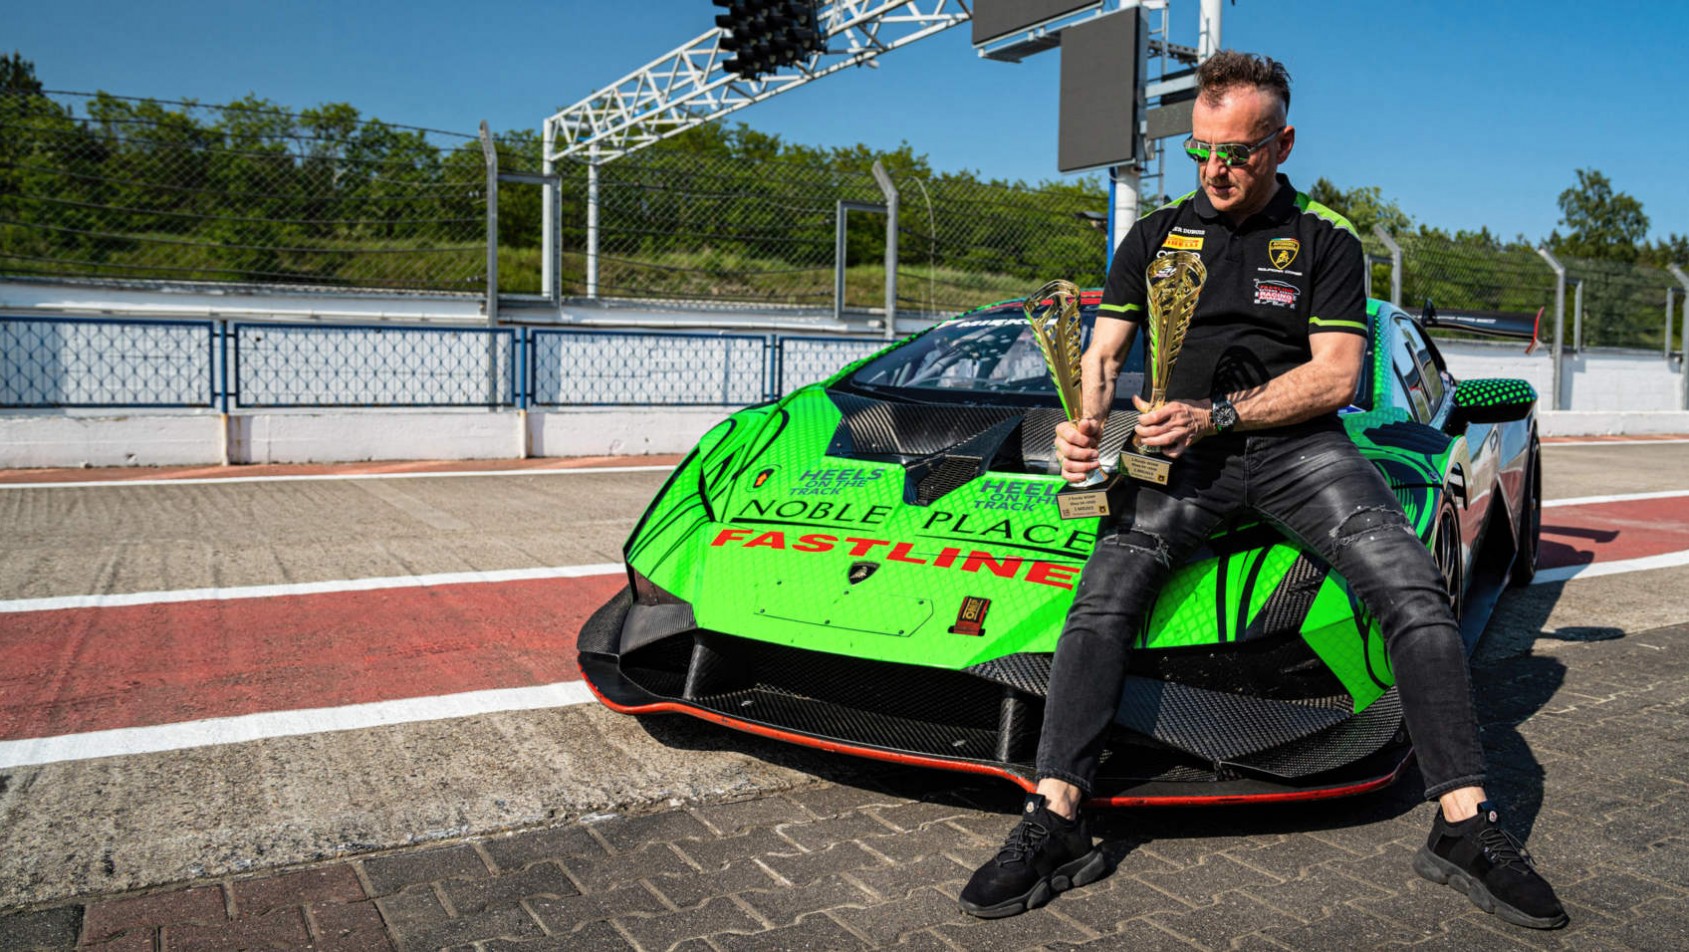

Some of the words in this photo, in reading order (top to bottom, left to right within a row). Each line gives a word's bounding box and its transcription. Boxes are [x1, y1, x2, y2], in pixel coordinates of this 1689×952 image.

[1259, 291, 1293, 300] RACING
[799, 468, 885, 481] HEELS
[804, 480, 831, 488] ON
[836, 480, 868, 488] THE
[980, 480, 1058, 496] HEEL
[789, 487, 842, 496] TRACK
[990, 493, 1020, 502] ON
[974, 500, 1036, 512] TRACK
[739, 499, 893, 525] NOBLE
[922, 511, 1097, 553] PLACE
[711, 529, 1080, 591] FASTLINE
